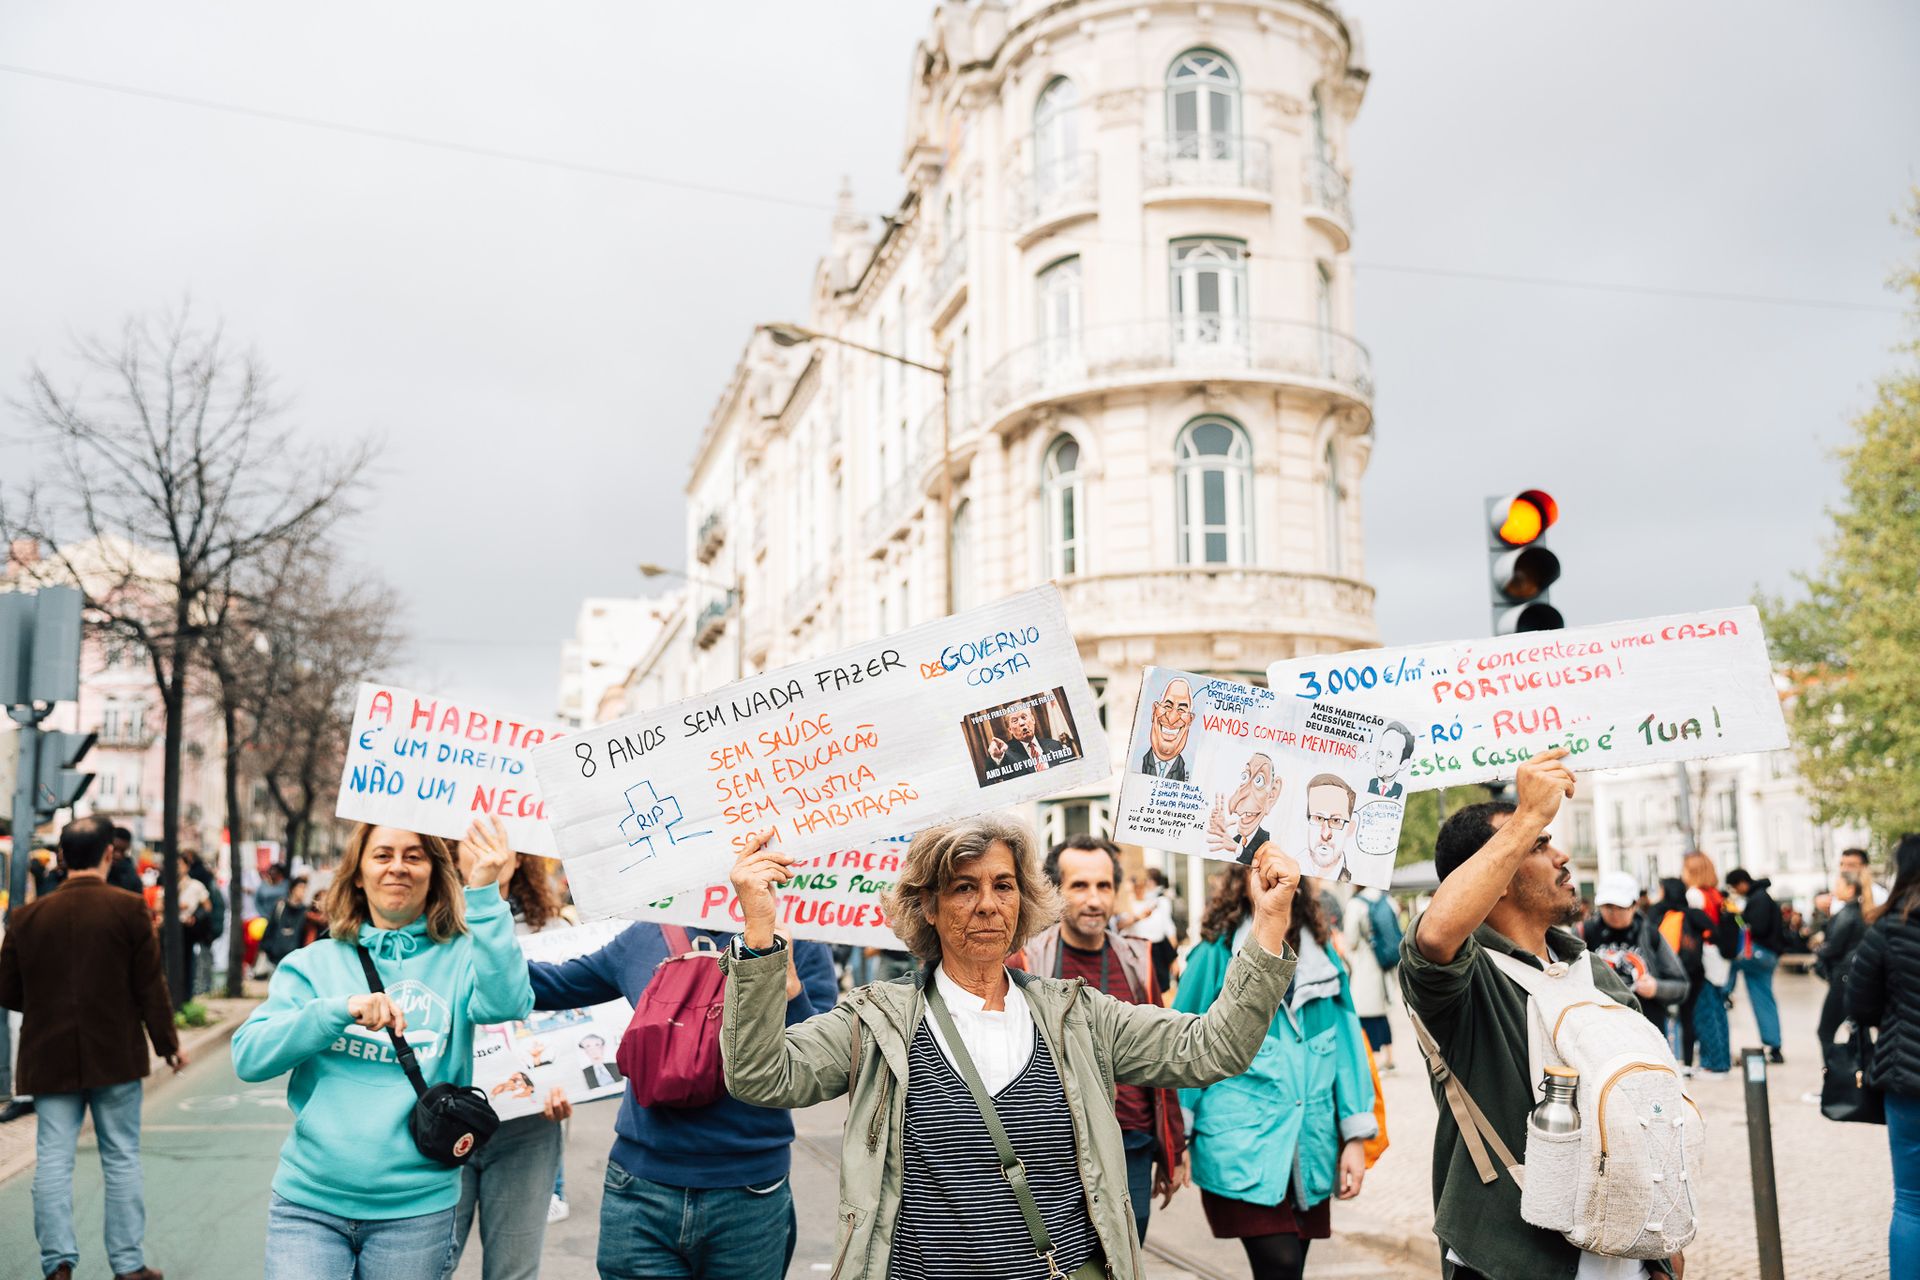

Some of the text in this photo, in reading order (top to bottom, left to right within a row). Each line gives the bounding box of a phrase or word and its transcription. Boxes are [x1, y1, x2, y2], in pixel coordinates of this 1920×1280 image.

[1611, 634, 1655, 650] uma
[1661, 620, 1739, 641] CASA
[966, 652, 1031, 687] COSTA
[991, 709, 1008, 720] FIRED
[1039, 694, 1055, 705] FIRED
[1260, 689, 1275, 700] DOS
[369, 690, 569, 749] A HABITA
[575, 649, 907, 778] 8 ANOS SEM NADA FAZER
[1313, 702, 1384, 726] MAIS HABITAÇÃO
[707, 712, 834, 772] SEM SAÚDE
[1203, 714, 1357, 759] VAMOS CONTAR MENTIRAS
[1306, 721, 1323, 731] DEU
[1324, 726, 1364, 743] BARRACA
[1598, 725, 1615, 750] é
[393, 736, 428, 760] UM
[437, 743, 524, 775] DIREITO
[986, 769, 1001, 780] AND
[1001, 765, 1014, 776] ALL
[1014, 761, 1024, 772] OF
[1023, 757, 1038, 769] YOU
[1038, 752, 1052, 763] ARE
[1052, 747, 1072, 759] FIRED
[349, 759, 405, 796] NÃO
[417, 776, 456, 806] UM
[715, 772, 763, 803] SEM
[722, 764, 877, 825] SEM JUSTIÇA
[1151, 789, 1156, 797] 2
[793, 782, 919, 836] HABITAÇÃO
[1149, 798, 1154, 806] 3
[637, 804, 664, 831] RIP
[1140, 825, 1165, 835] TUTANO
[1193, 822, 1205, 830] ATÉ
